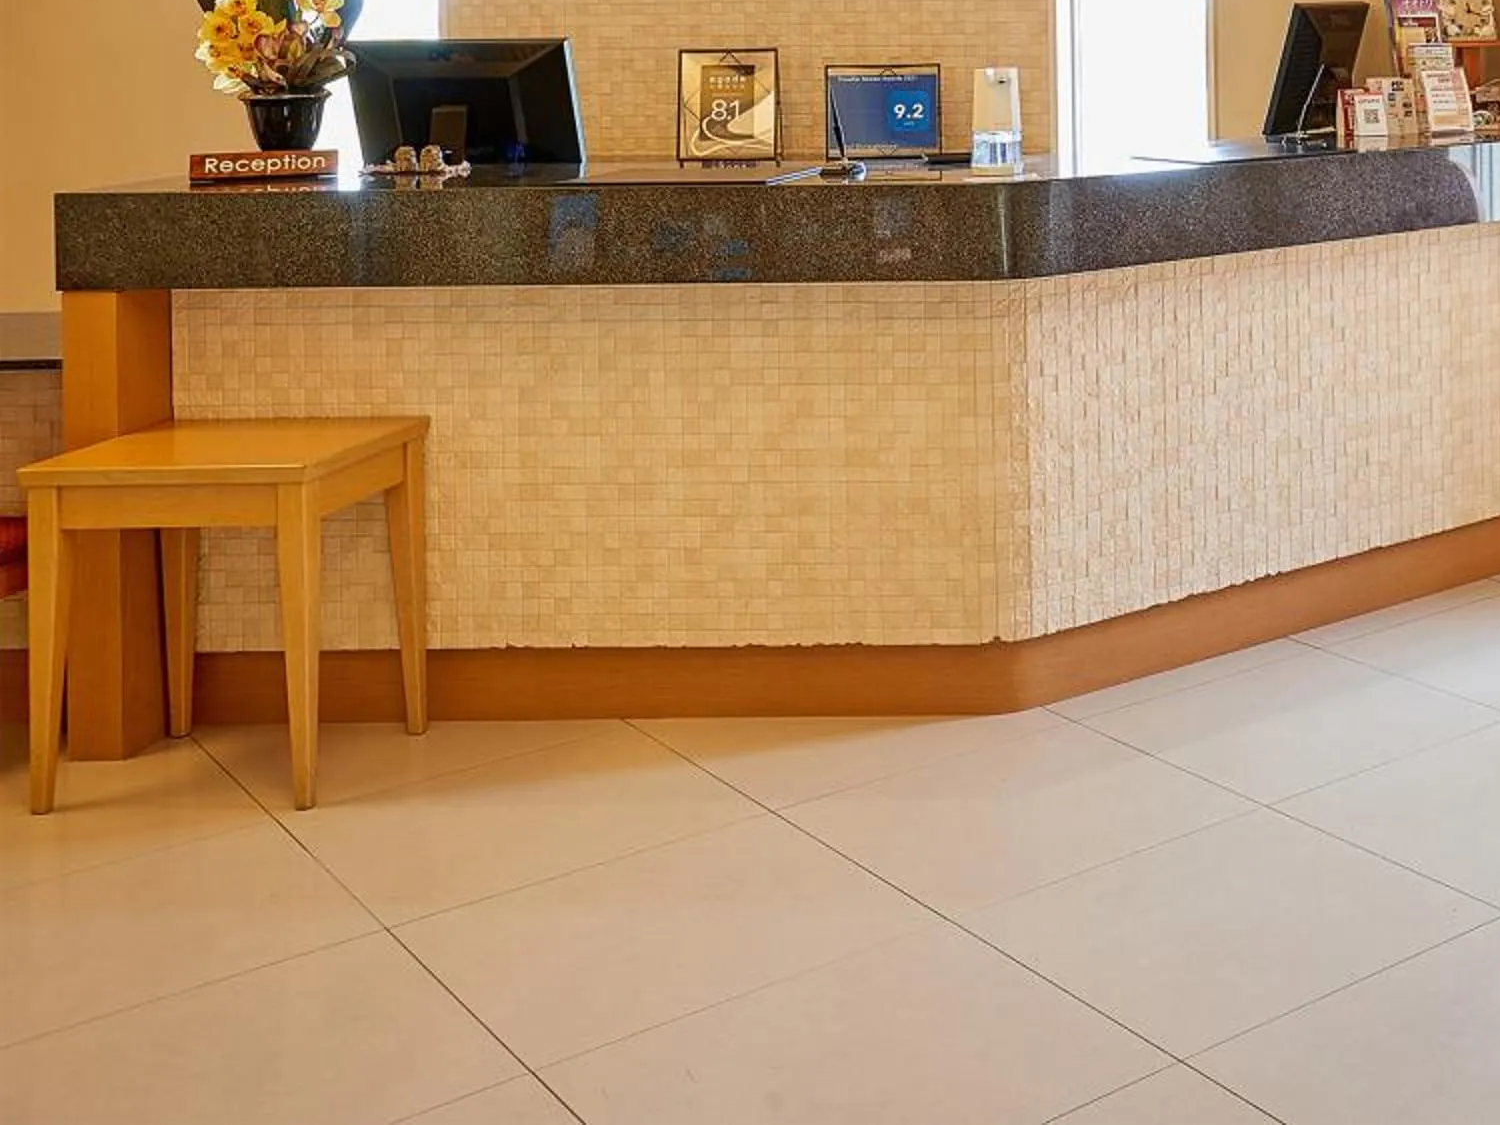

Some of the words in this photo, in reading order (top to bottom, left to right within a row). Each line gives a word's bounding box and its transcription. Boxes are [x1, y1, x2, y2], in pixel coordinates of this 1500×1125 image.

[711, 99, 739, 121] 8.1
[894, 103, 924, 119] 9.2
[204, 154, 325, 173] Reception
